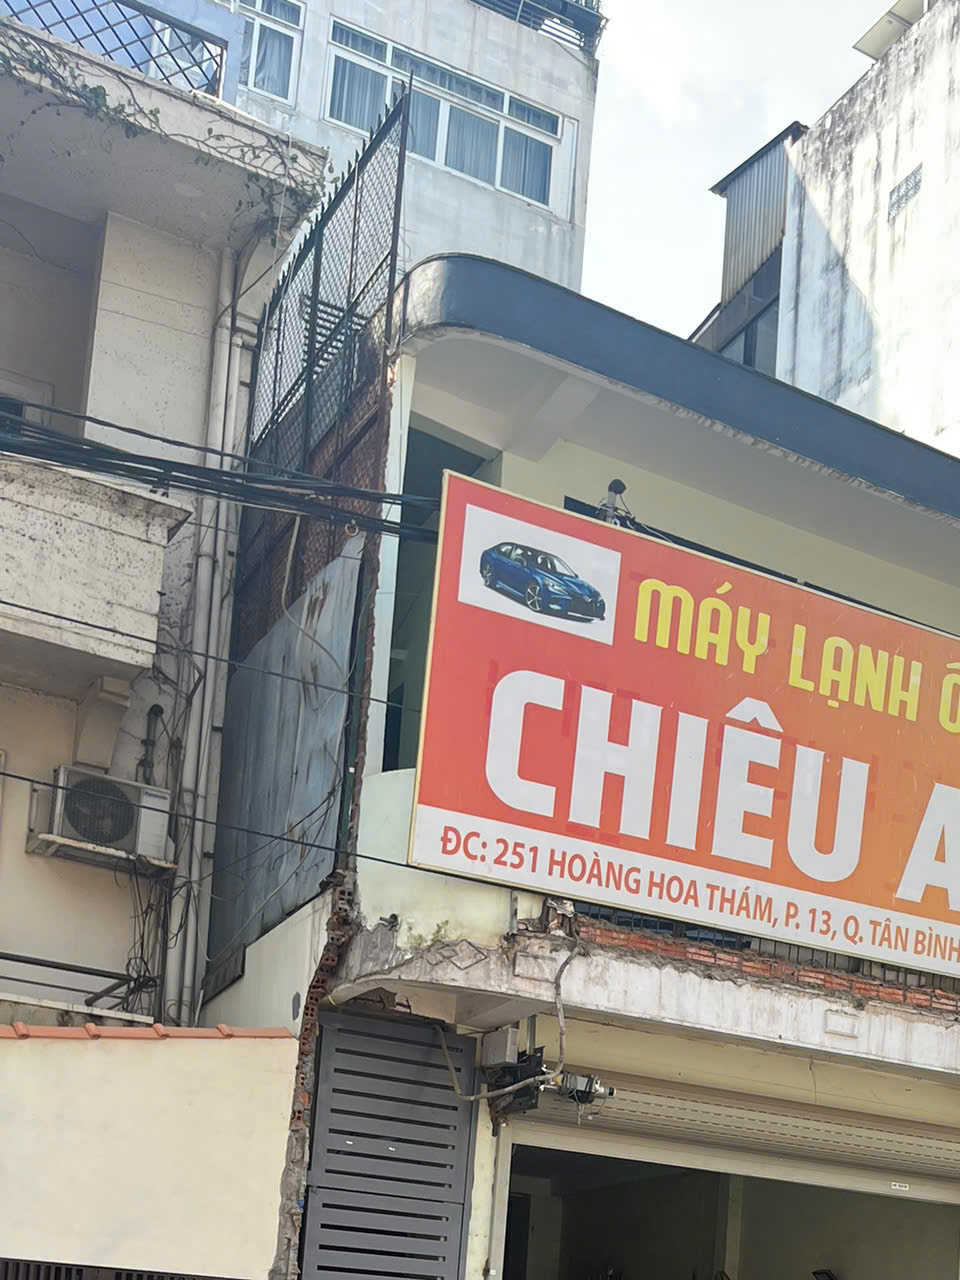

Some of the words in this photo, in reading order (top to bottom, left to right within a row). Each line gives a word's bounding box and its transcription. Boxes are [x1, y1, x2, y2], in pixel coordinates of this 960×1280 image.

[634, 579, 771, 674] MÁY
[788, 623, 922, 722] LẠNH
[485, 670, 870, 883] CHIÊU
[440, 825, 488, 862] ĐC:
[493, 838, 539, 873] 251
[548, 848, 641, 895] HOÀNG
[647, 871, 700, 908] HOA
[706, 884, 779, 929] THÁM,
[784, 901, 801, 930] P.
[809, 908, 837, 941] 13,
[843, 915, 864, 946] Q.
[869, 917, 909, 953] TÂN
